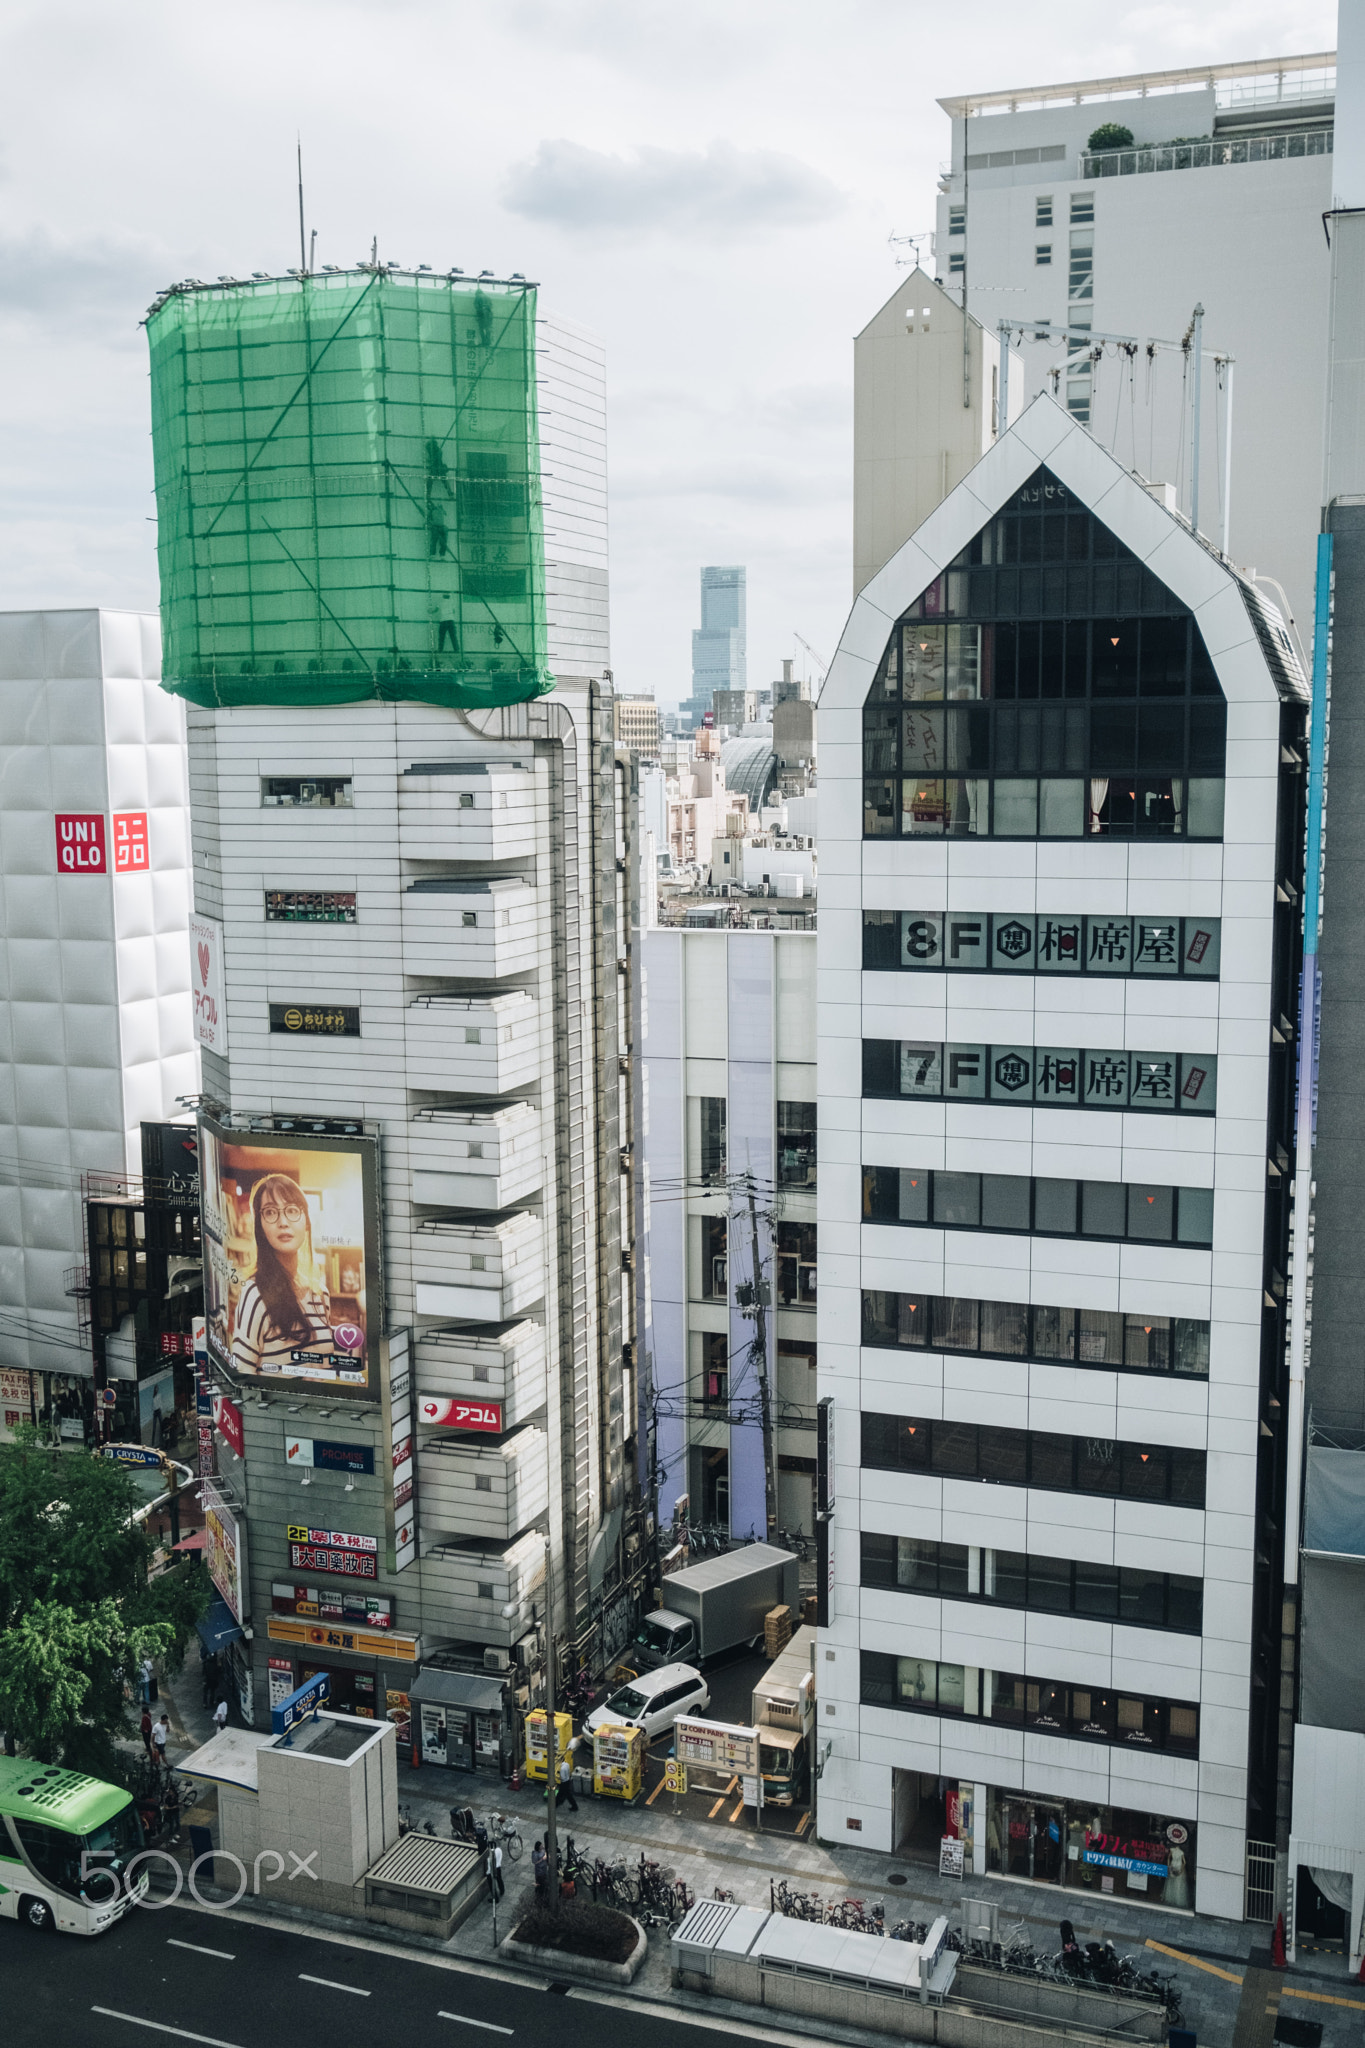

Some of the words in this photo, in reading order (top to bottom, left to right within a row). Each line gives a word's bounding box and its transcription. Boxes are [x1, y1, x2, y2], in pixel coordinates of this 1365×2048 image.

[61, 822, 96, 842] UNI
[117, 820, 144, 841] ユニ
[62, 846, 101, 869] QLO
[118, 844, 145, 865] クロ
[906, 920, 981, 959] 8F
[1039, 921, 1177, 964] 相席屋
[194, 989, 218, 1026] アイフル
[907, 1049, 980, 1089] 7F
[1037, 1054, 1173, 1100] 相席屋
[0, 1373, 15, 1383] TAX
[456, 1406, 498, 1424] アコム
[116, 1449, 146, 1460] CRYSTA
[322, 1448, 364, 1463] PROMISE
[395, 1450, 409, 1464] アコム
[288, 1526, 307, 1539] 2F
[332, 1533, 361, 1547] 免税
[370, 1618, 387, 1627] アコム
[327, 1631, 354, 1649] 松屋
[319, 1683, 325, 1697] P
[688, 1726, 706, 1735] COIN
[707, 1728, 725, 1738] PARK
